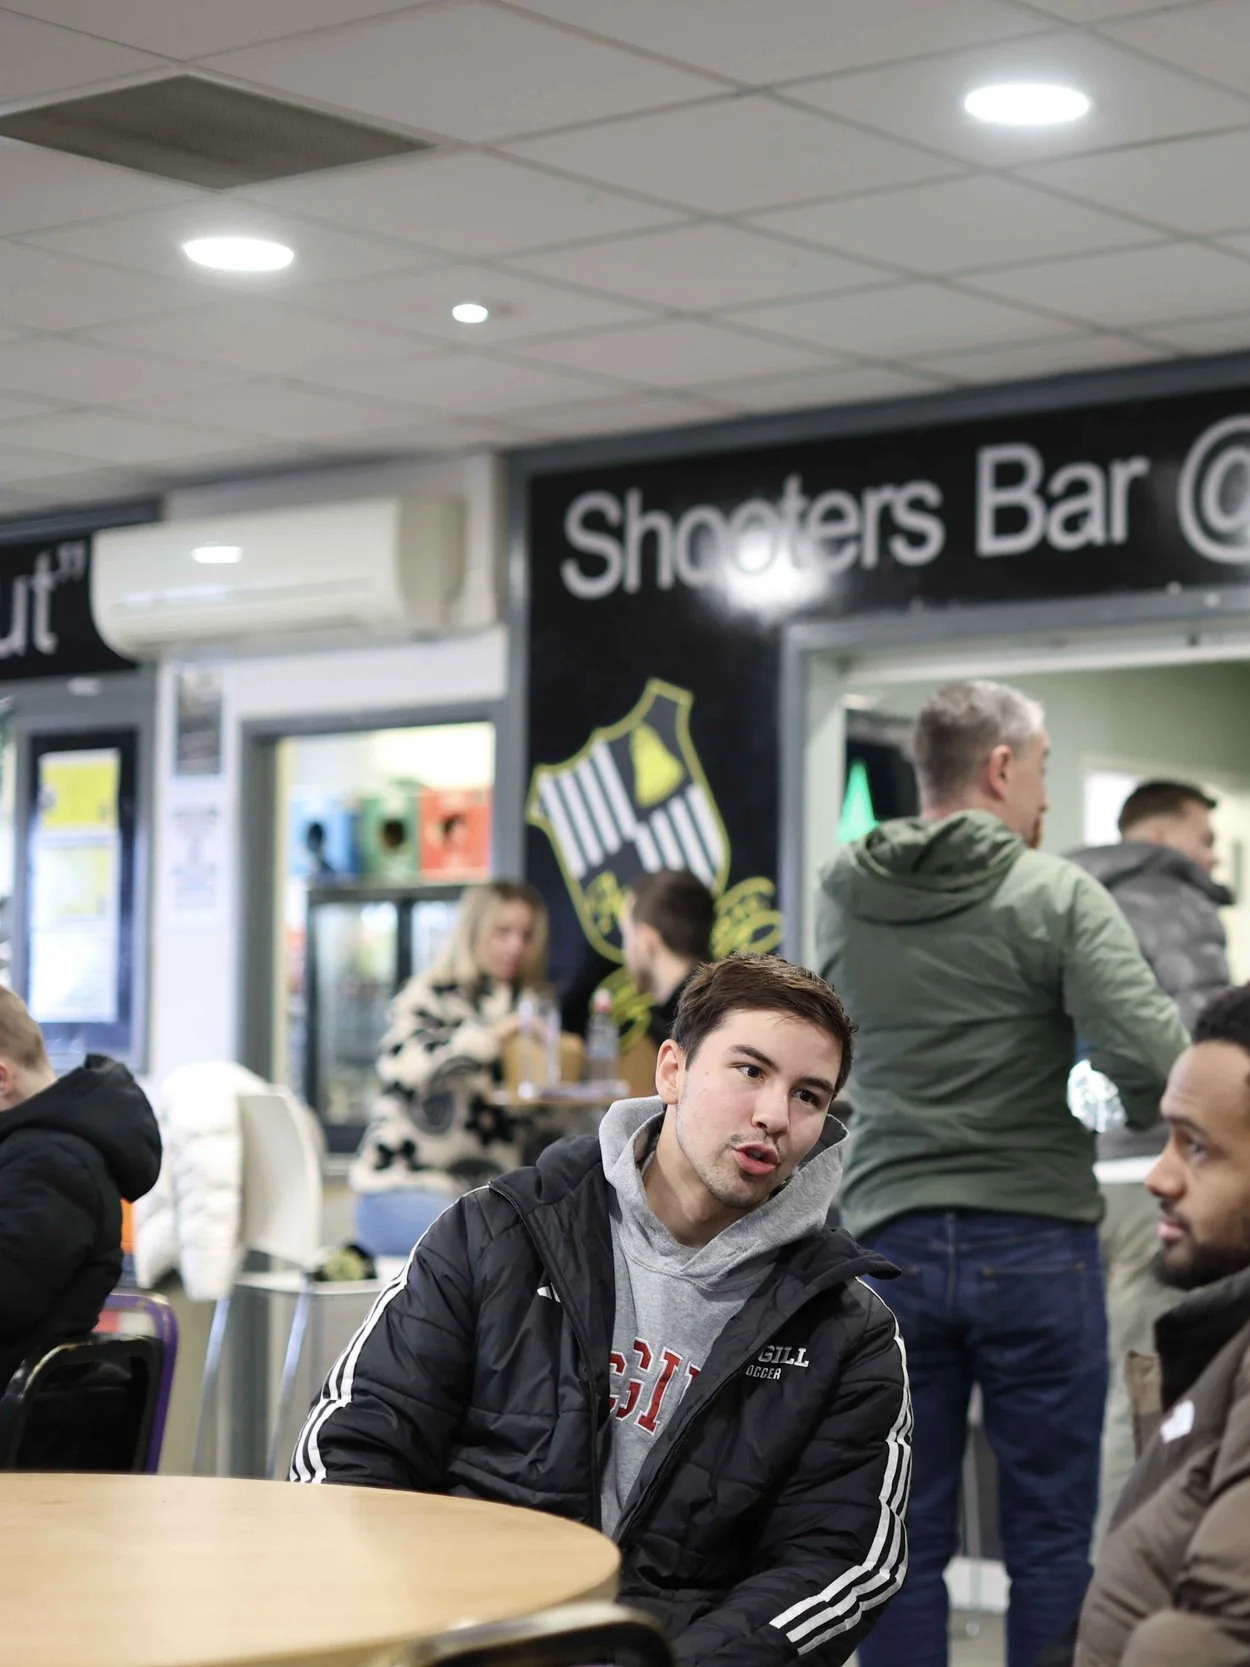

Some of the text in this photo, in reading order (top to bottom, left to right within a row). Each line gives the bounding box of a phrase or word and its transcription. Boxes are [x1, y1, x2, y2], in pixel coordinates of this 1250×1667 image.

[560, 473, 947, 600] Shooters
[975, 443, 1151, 558] Bar
[757, 1344, 810, 1368] GILL
[745, 1364, 782, 1380] OCCER
